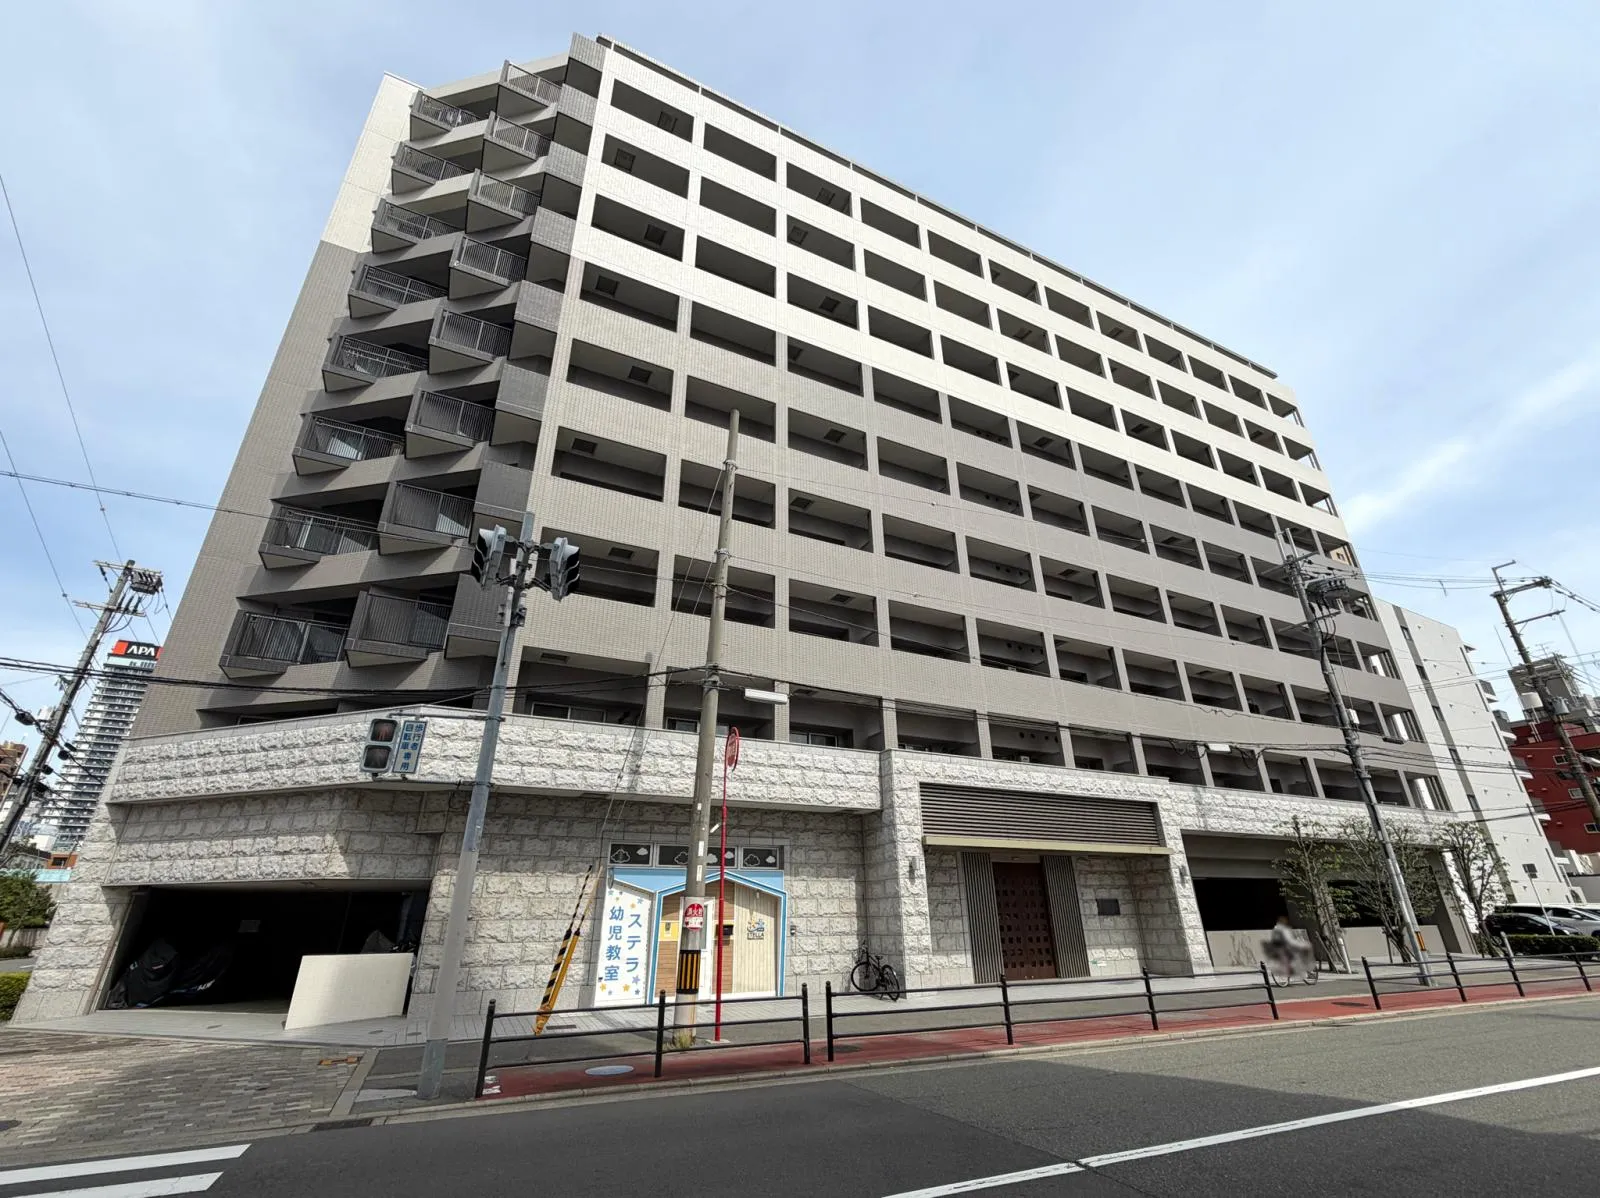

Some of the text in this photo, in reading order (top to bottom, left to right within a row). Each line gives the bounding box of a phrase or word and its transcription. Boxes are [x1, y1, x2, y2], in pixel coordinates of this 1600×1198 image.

[127, 645, 155, 656] APA
[604, 905, 624, 982] 幼児教室
[625, 913, 642, 973] ステラ
